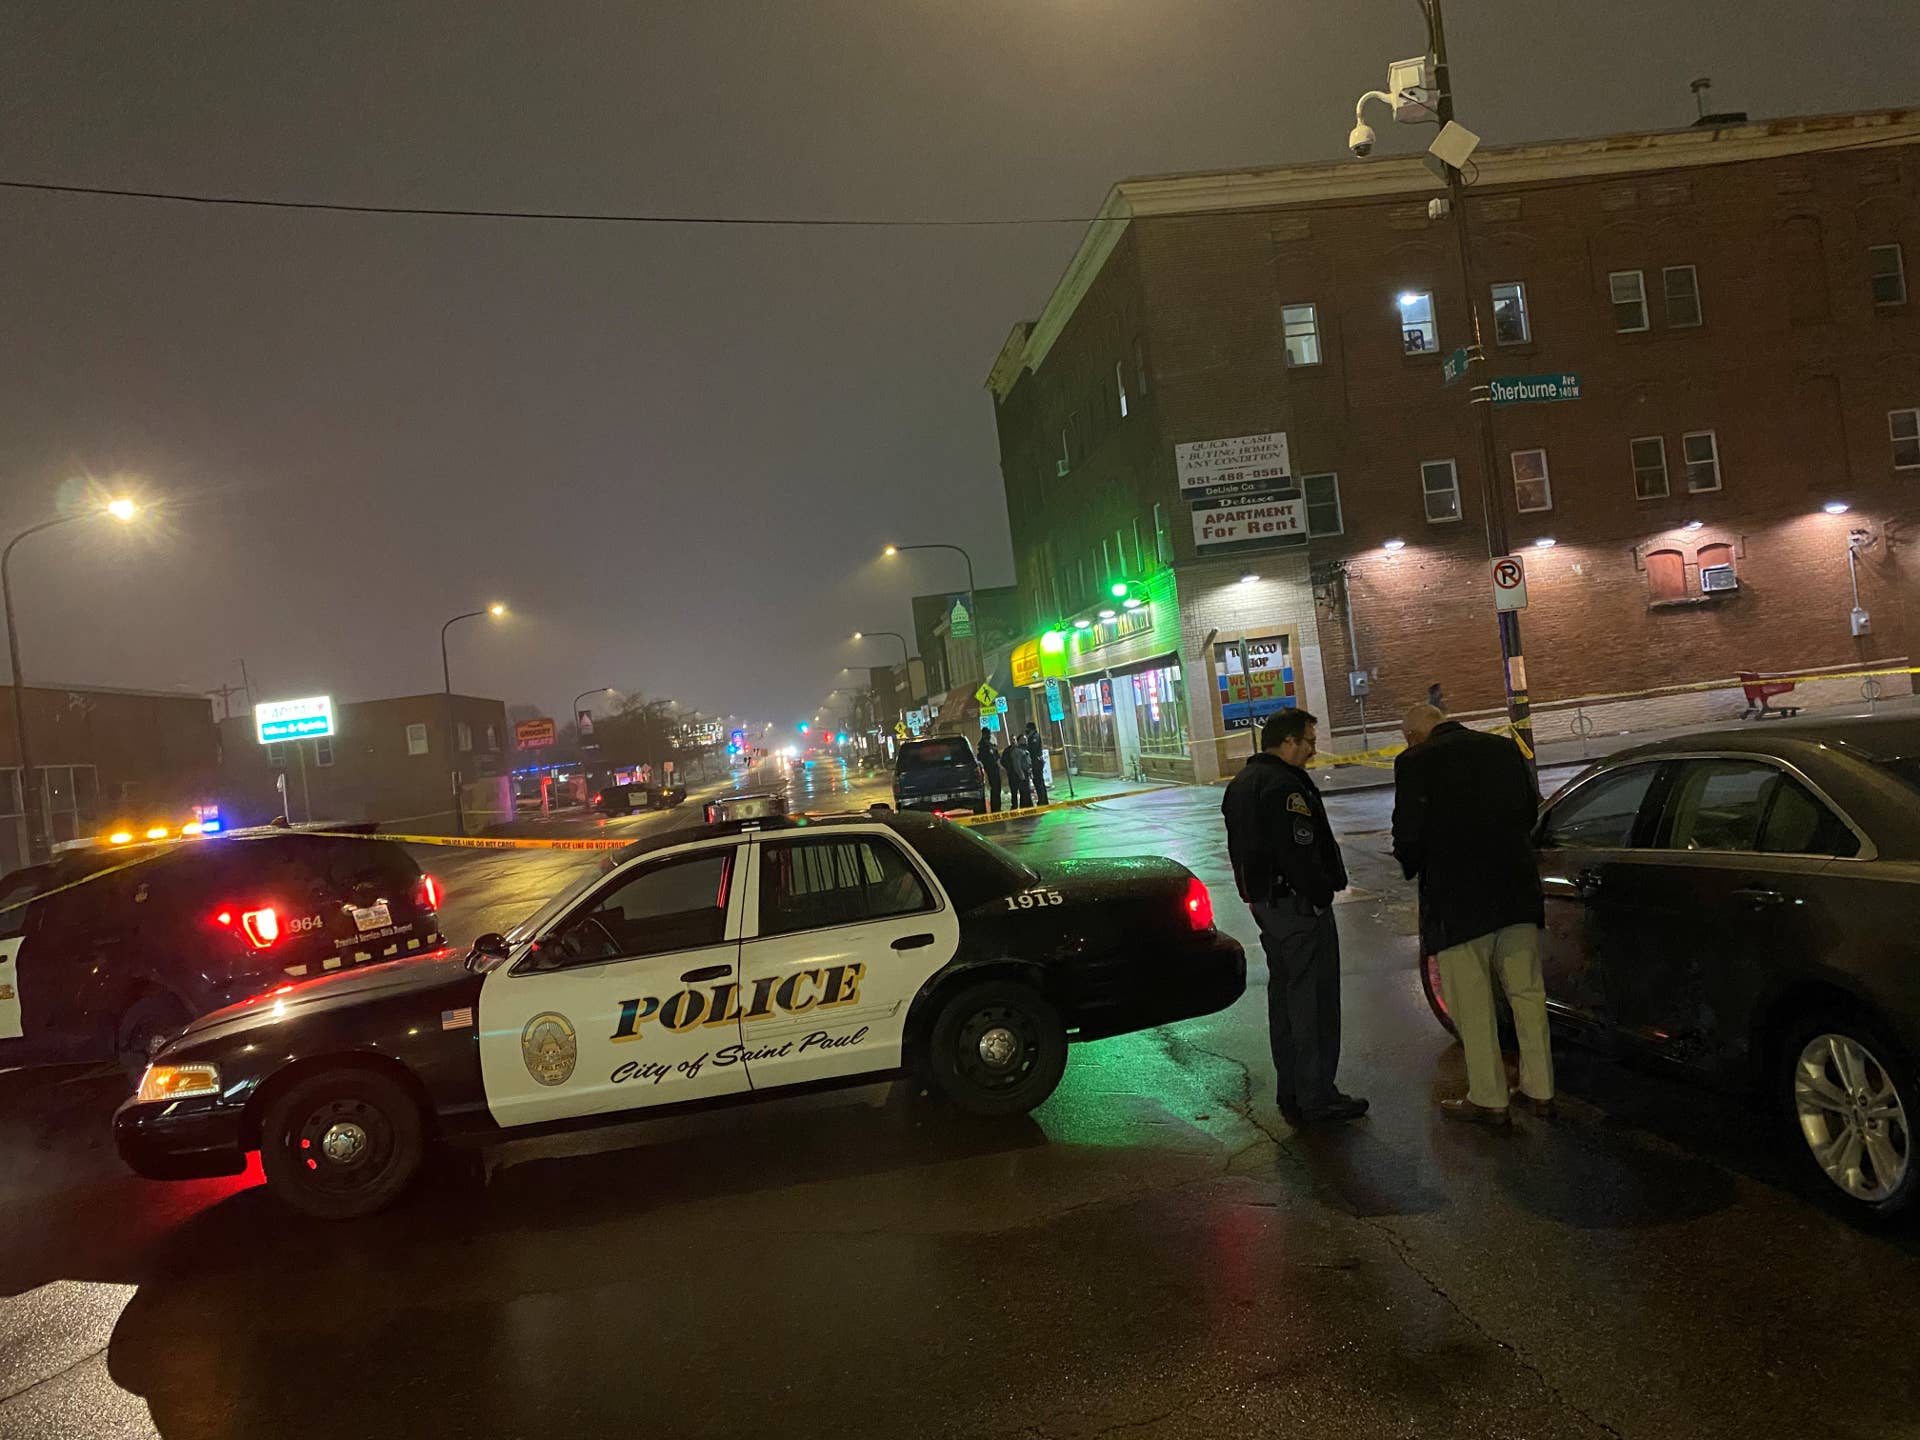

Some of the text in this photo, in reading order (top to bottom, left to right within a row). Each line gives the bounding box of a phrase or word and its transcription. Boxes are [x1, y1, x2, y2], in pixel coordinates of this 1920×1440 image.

[1562, 375, 1576, 385] Ave
[1490, 381, 1557, 401] Sherburne
[1191, 434, 1273, 451] QUICK CASH
[1186, 452, 1281, 469] ANY CONDITION
[1189, 443, 1279, 461] BUYING HOMES
[1217, 495, 1275, 507] Deluxe
[1205, 505, 1294, 525] APARTMENT
[1202, 517, 1298, 539] For Rent
[1229, 674, 1244, 686] WE
[1237, 684, 1275, 700] EBT
[498, 841, 516, 849] CROSS
[551, 841, 571, 849] POLICE
[607, 841, 625, 849] CROSS
[1004, 891, 1063, 910] 1915
[609, 963, 867, 1043] POLICE
[610, 1026, 869, 1085] City of Saint Paul
